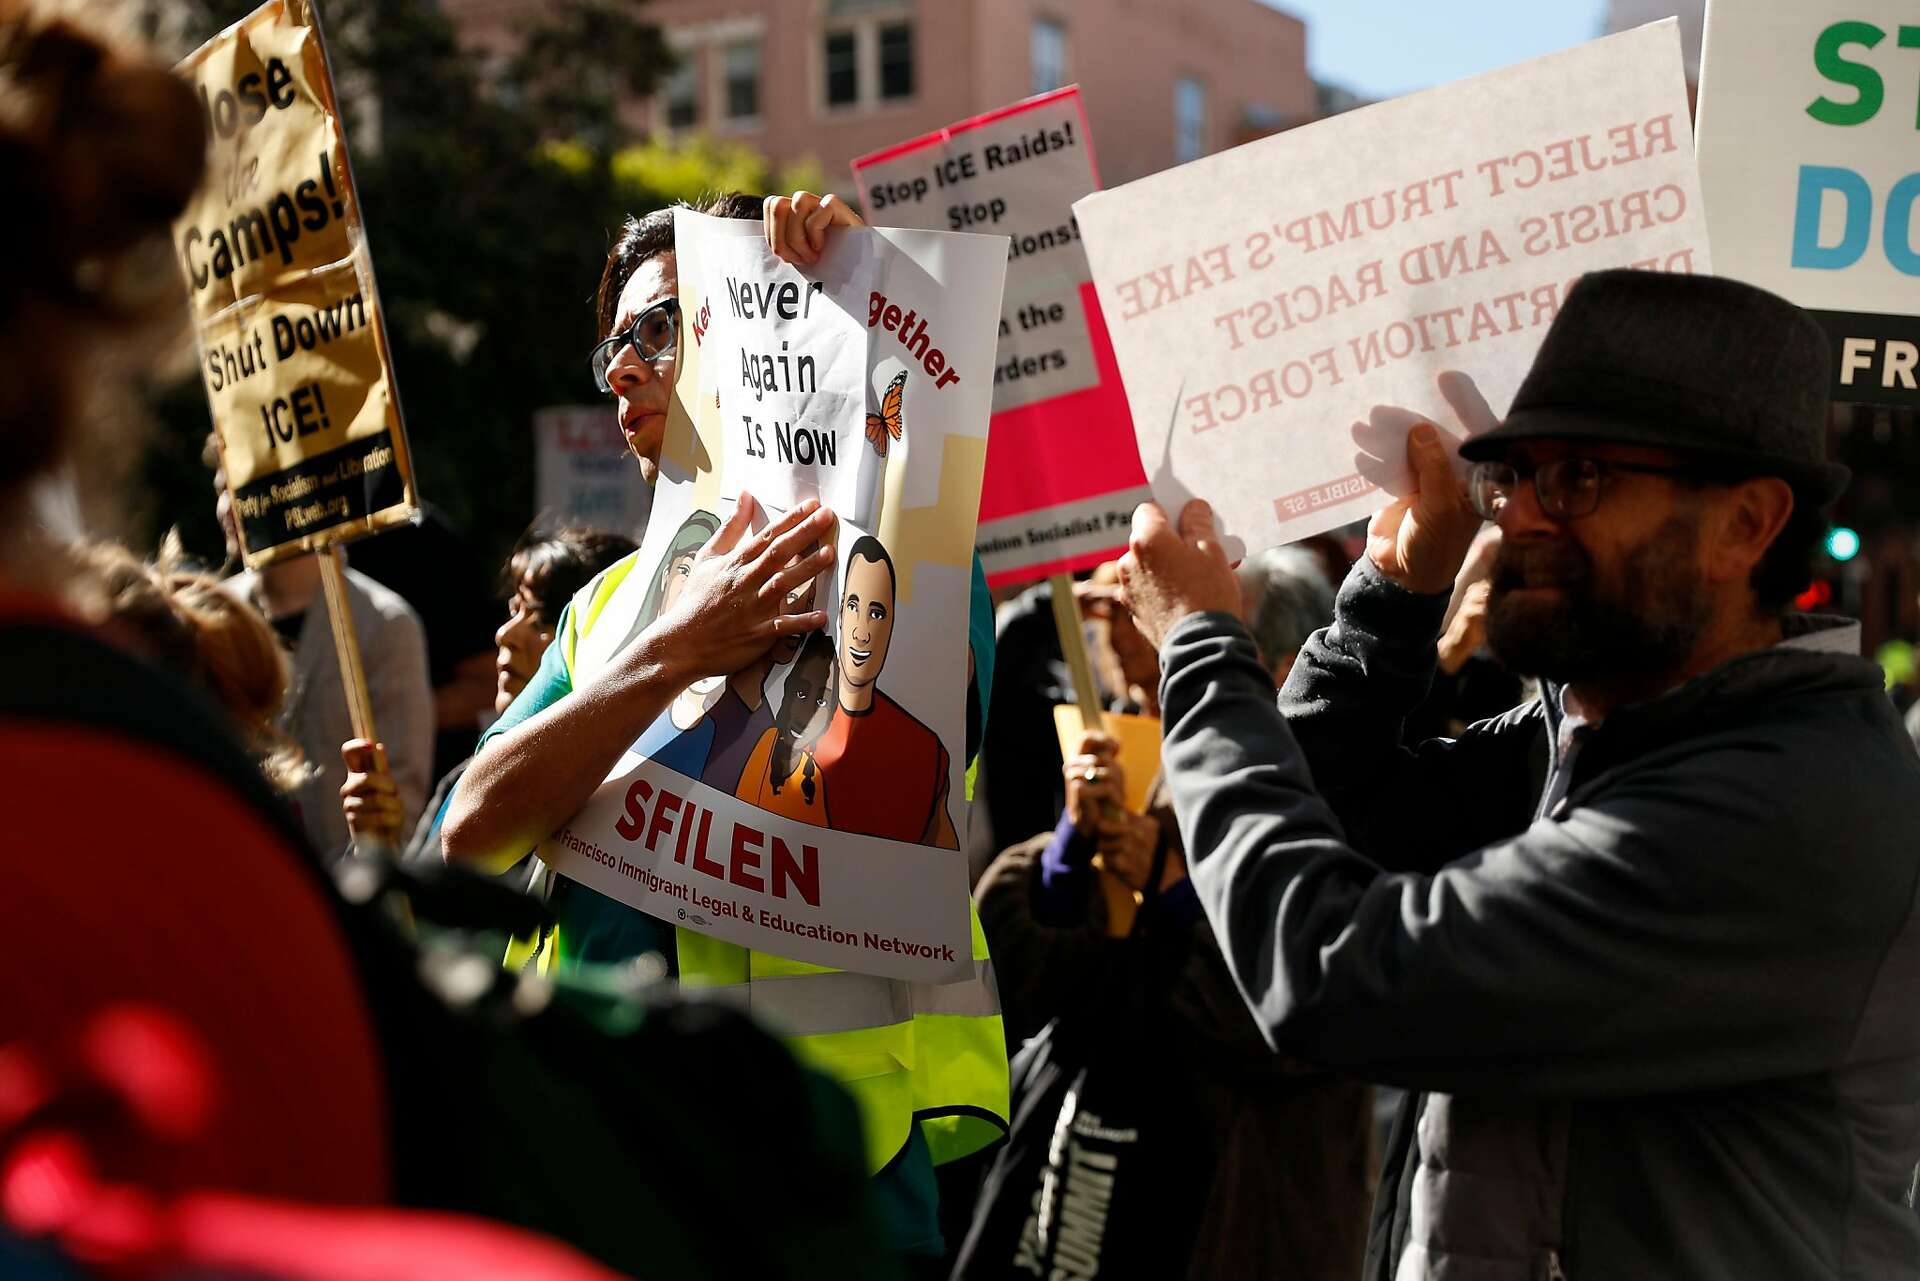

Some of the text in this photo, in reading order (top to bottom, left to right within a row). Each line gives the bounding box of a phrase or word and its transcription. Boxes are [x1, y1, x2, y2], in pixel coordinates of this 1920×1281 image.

[199, 57, 296, 143] lose
[869, 121, 1075, 211] Stop ICE Raids!
[184, 151, 345, 291] Camps!
[946, 198, 1007, 231] Stop
[1008, 216, 1080, 261] ions!
[726, 277, 824, 320] Never
[1017, 302, 1064, 332] the
[208, 293, 366, 392] Shut Down
[741, 341, 816, 402] Again
[867, 290, 961, 390] gether
[994, 350, 1067, 386] rders
[261, 383, 331, 449] ICE!
[742, 415, 766, 459] Is
[614, 778, 822, 908] SFILEN
[562, 829, 956, 963] Francisco Immigrant Legal & Education Network
